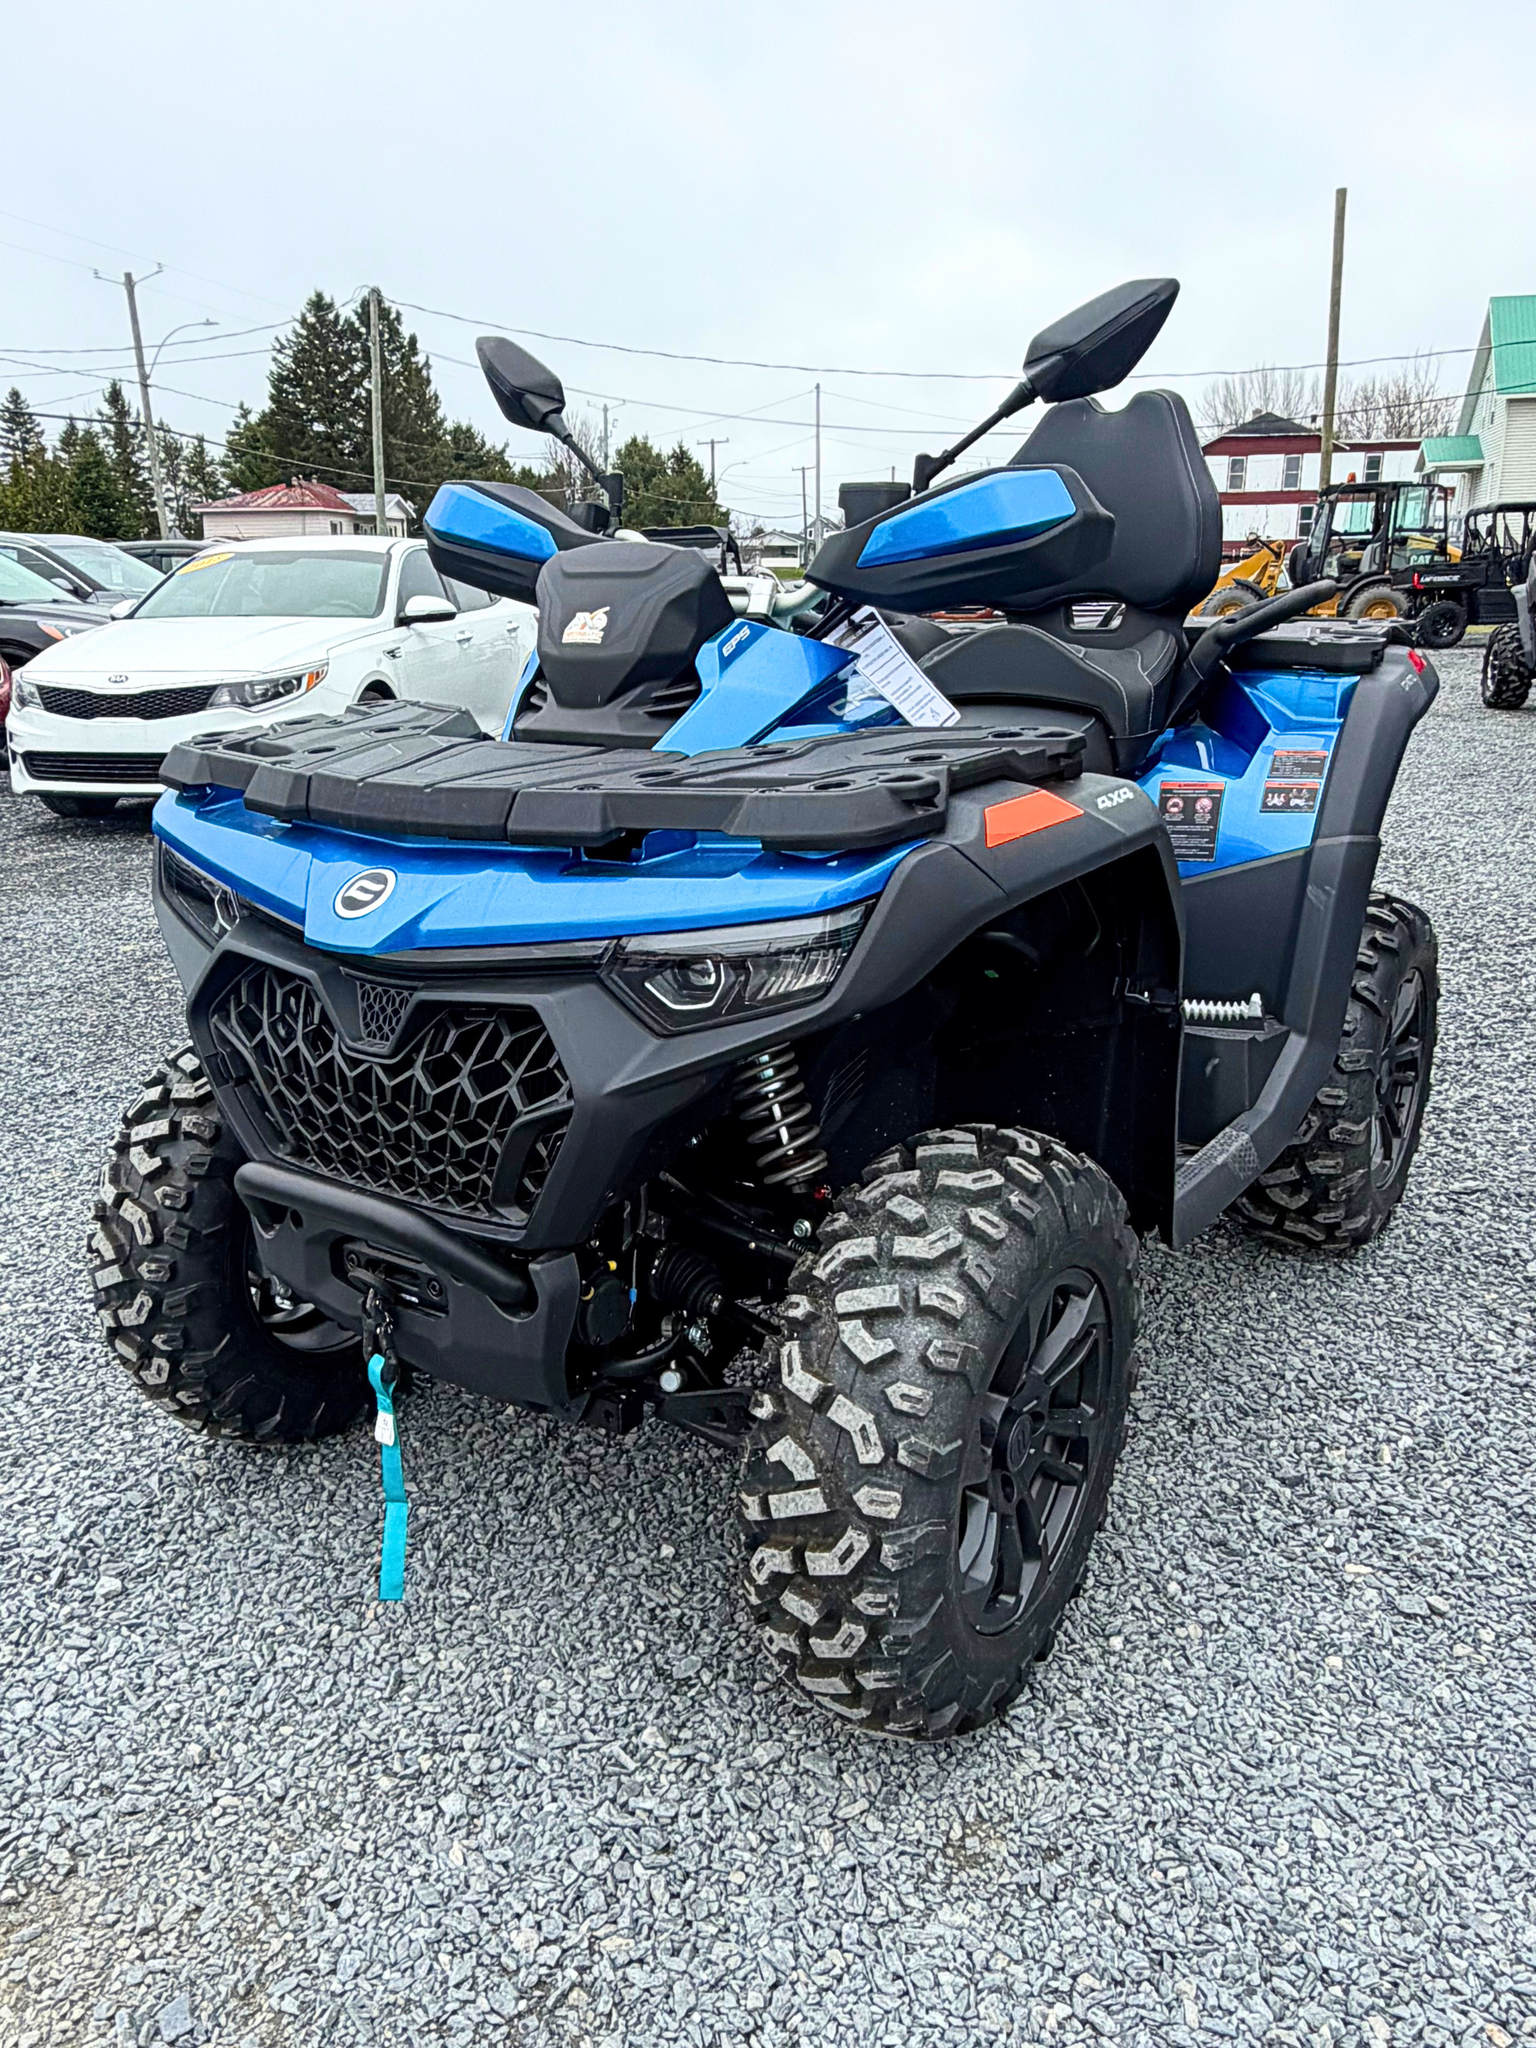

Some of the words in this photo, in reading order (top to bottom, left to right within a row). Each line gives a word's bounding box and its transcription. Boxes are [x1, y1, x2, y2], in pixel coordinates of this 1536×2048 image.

[1410, 554, 1432, 566] CAT
[722, 625, 751, 657] EPS
[109, 675, 129, 684] KIA
